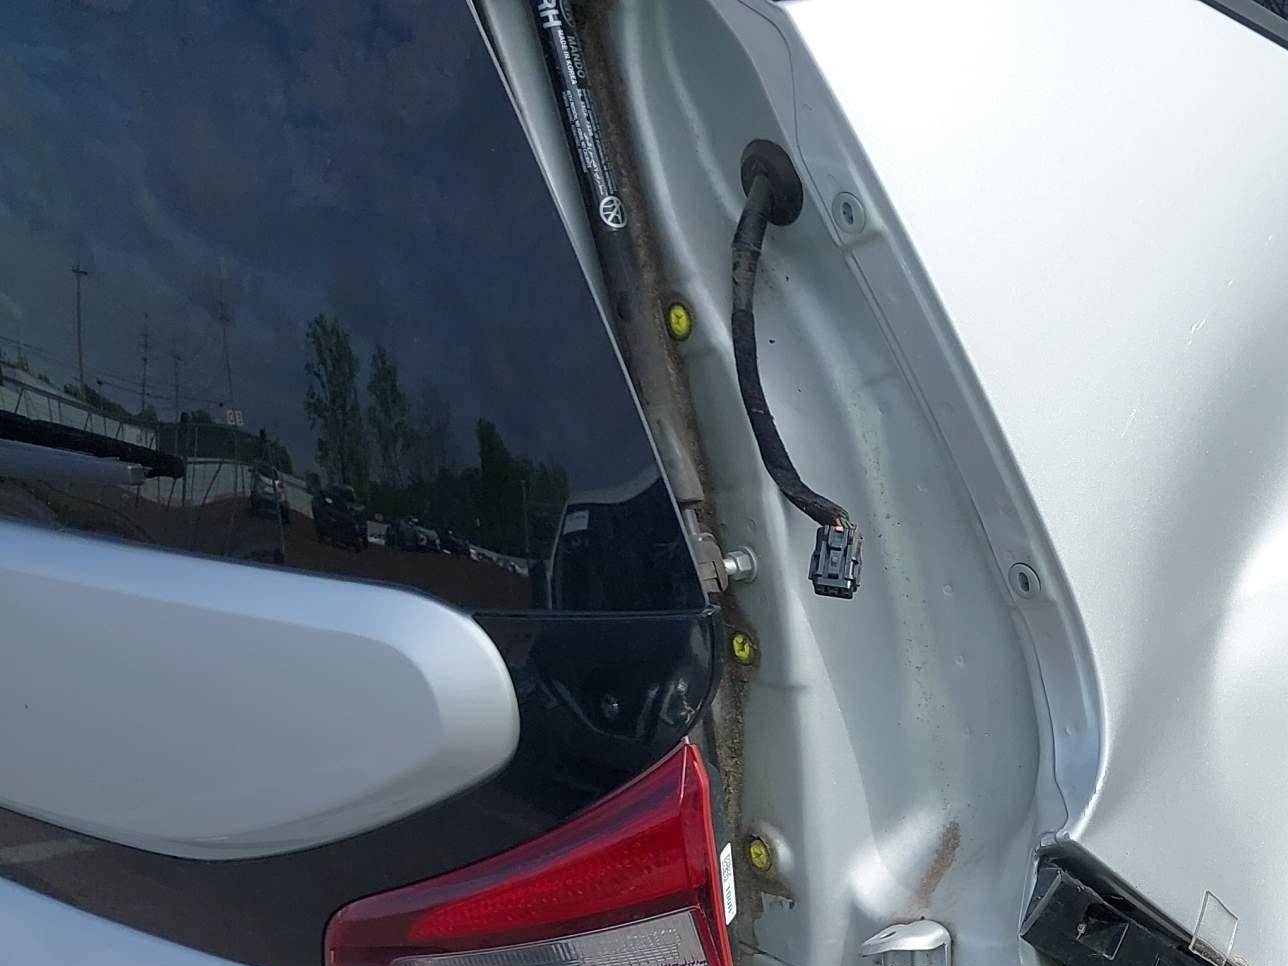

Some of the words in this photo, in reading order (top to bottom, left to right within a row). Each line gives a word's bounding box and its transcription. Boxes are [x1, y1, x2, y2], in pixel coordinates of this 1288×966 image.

[557, 29, 568, 51] MADE
[562, 51, 570, 60] IN
[566, 34, 586, 79] MANDO
[565, 59, 577, 84] KOREA
